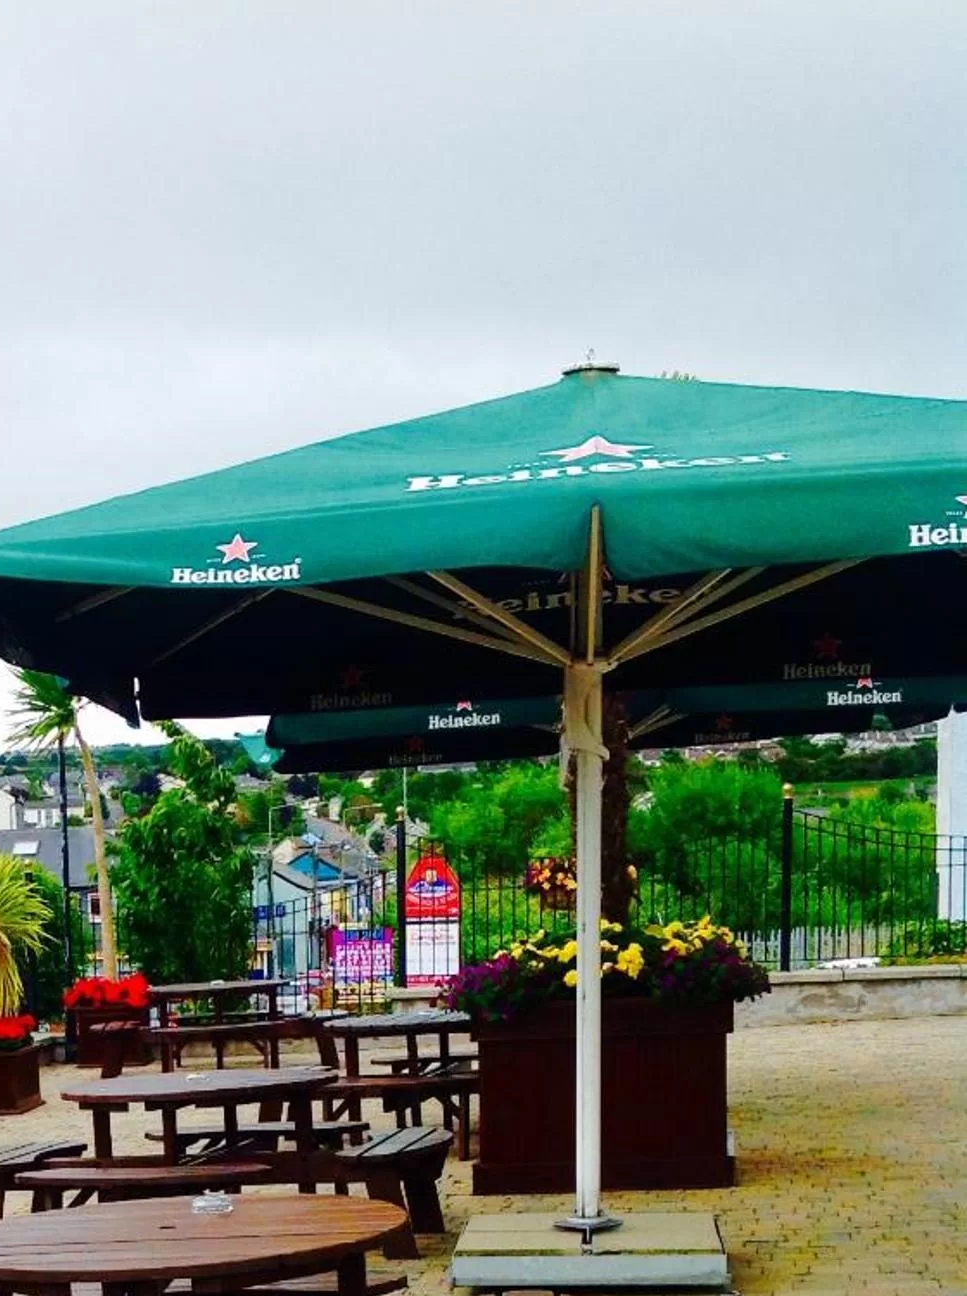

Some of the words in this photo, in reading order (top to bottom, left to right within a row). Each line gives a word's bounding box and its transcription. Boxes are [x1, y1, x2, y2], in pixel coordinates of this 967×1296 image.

[405, 452, 792, 491] Heineken
[908, 523, 967, 547] Hei
[171, 561, 301, 584] Heineken
[827, 691, 902, 706] Heineken
[428, 712, 501, 730] Heineken
